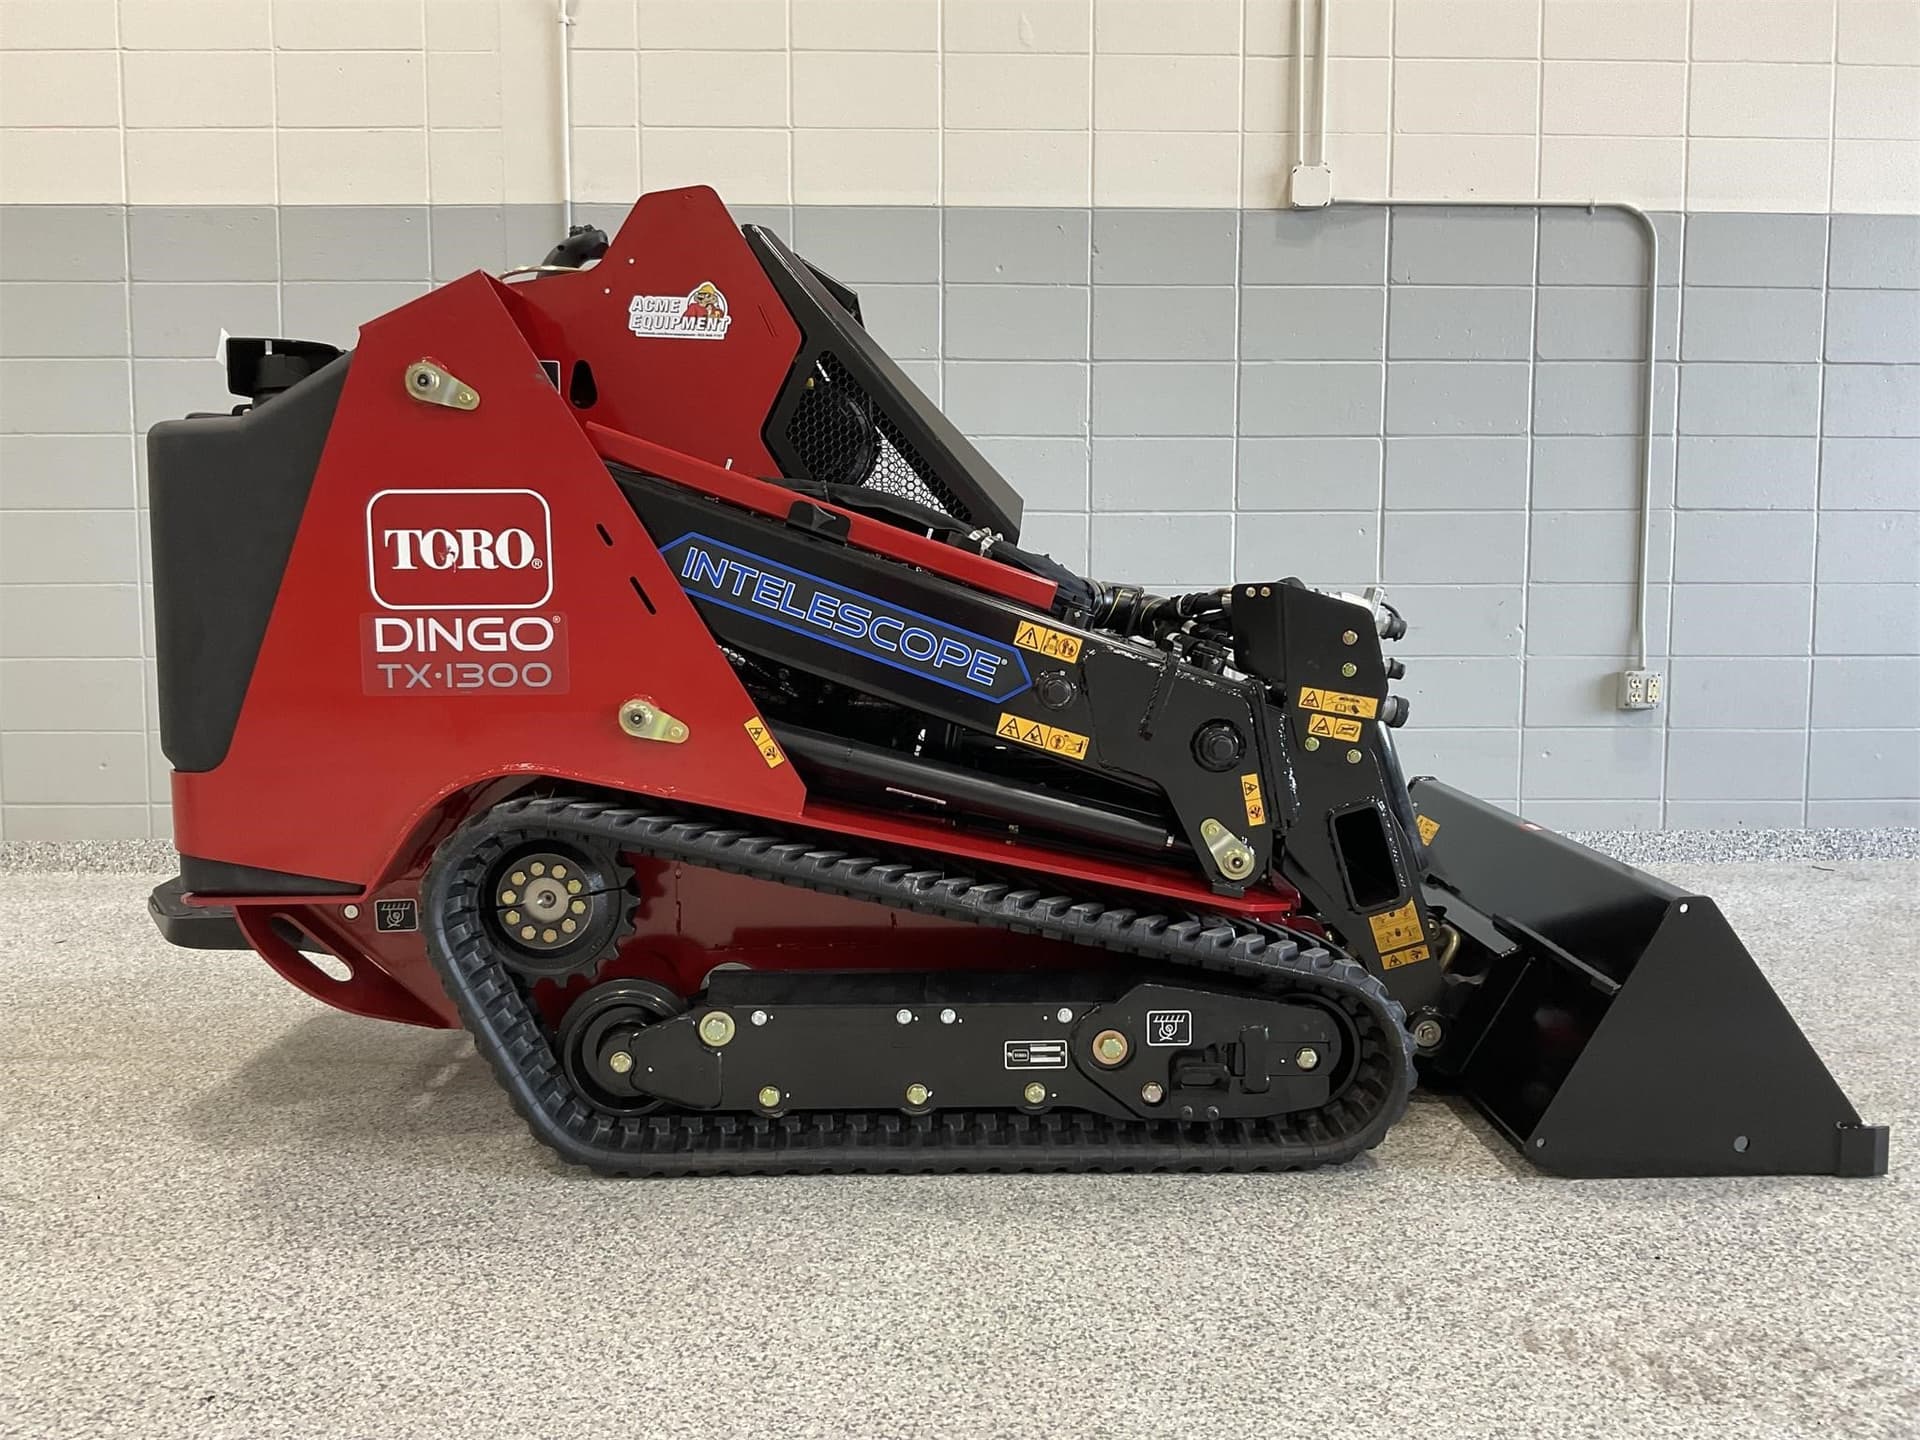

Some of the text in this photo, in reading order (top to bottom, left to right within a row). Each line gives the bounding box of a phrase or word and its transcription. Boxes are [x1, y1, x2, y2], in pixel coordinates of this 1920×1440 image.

[631, 298, 681, 313] ACME
[631, 314, 730, 332] EQUIPMENT
[384, 528, 535, 570] TORO
[681, 546, 1002, 687] INTELESCOPE
[375, 617, 554, 652] DINGO
